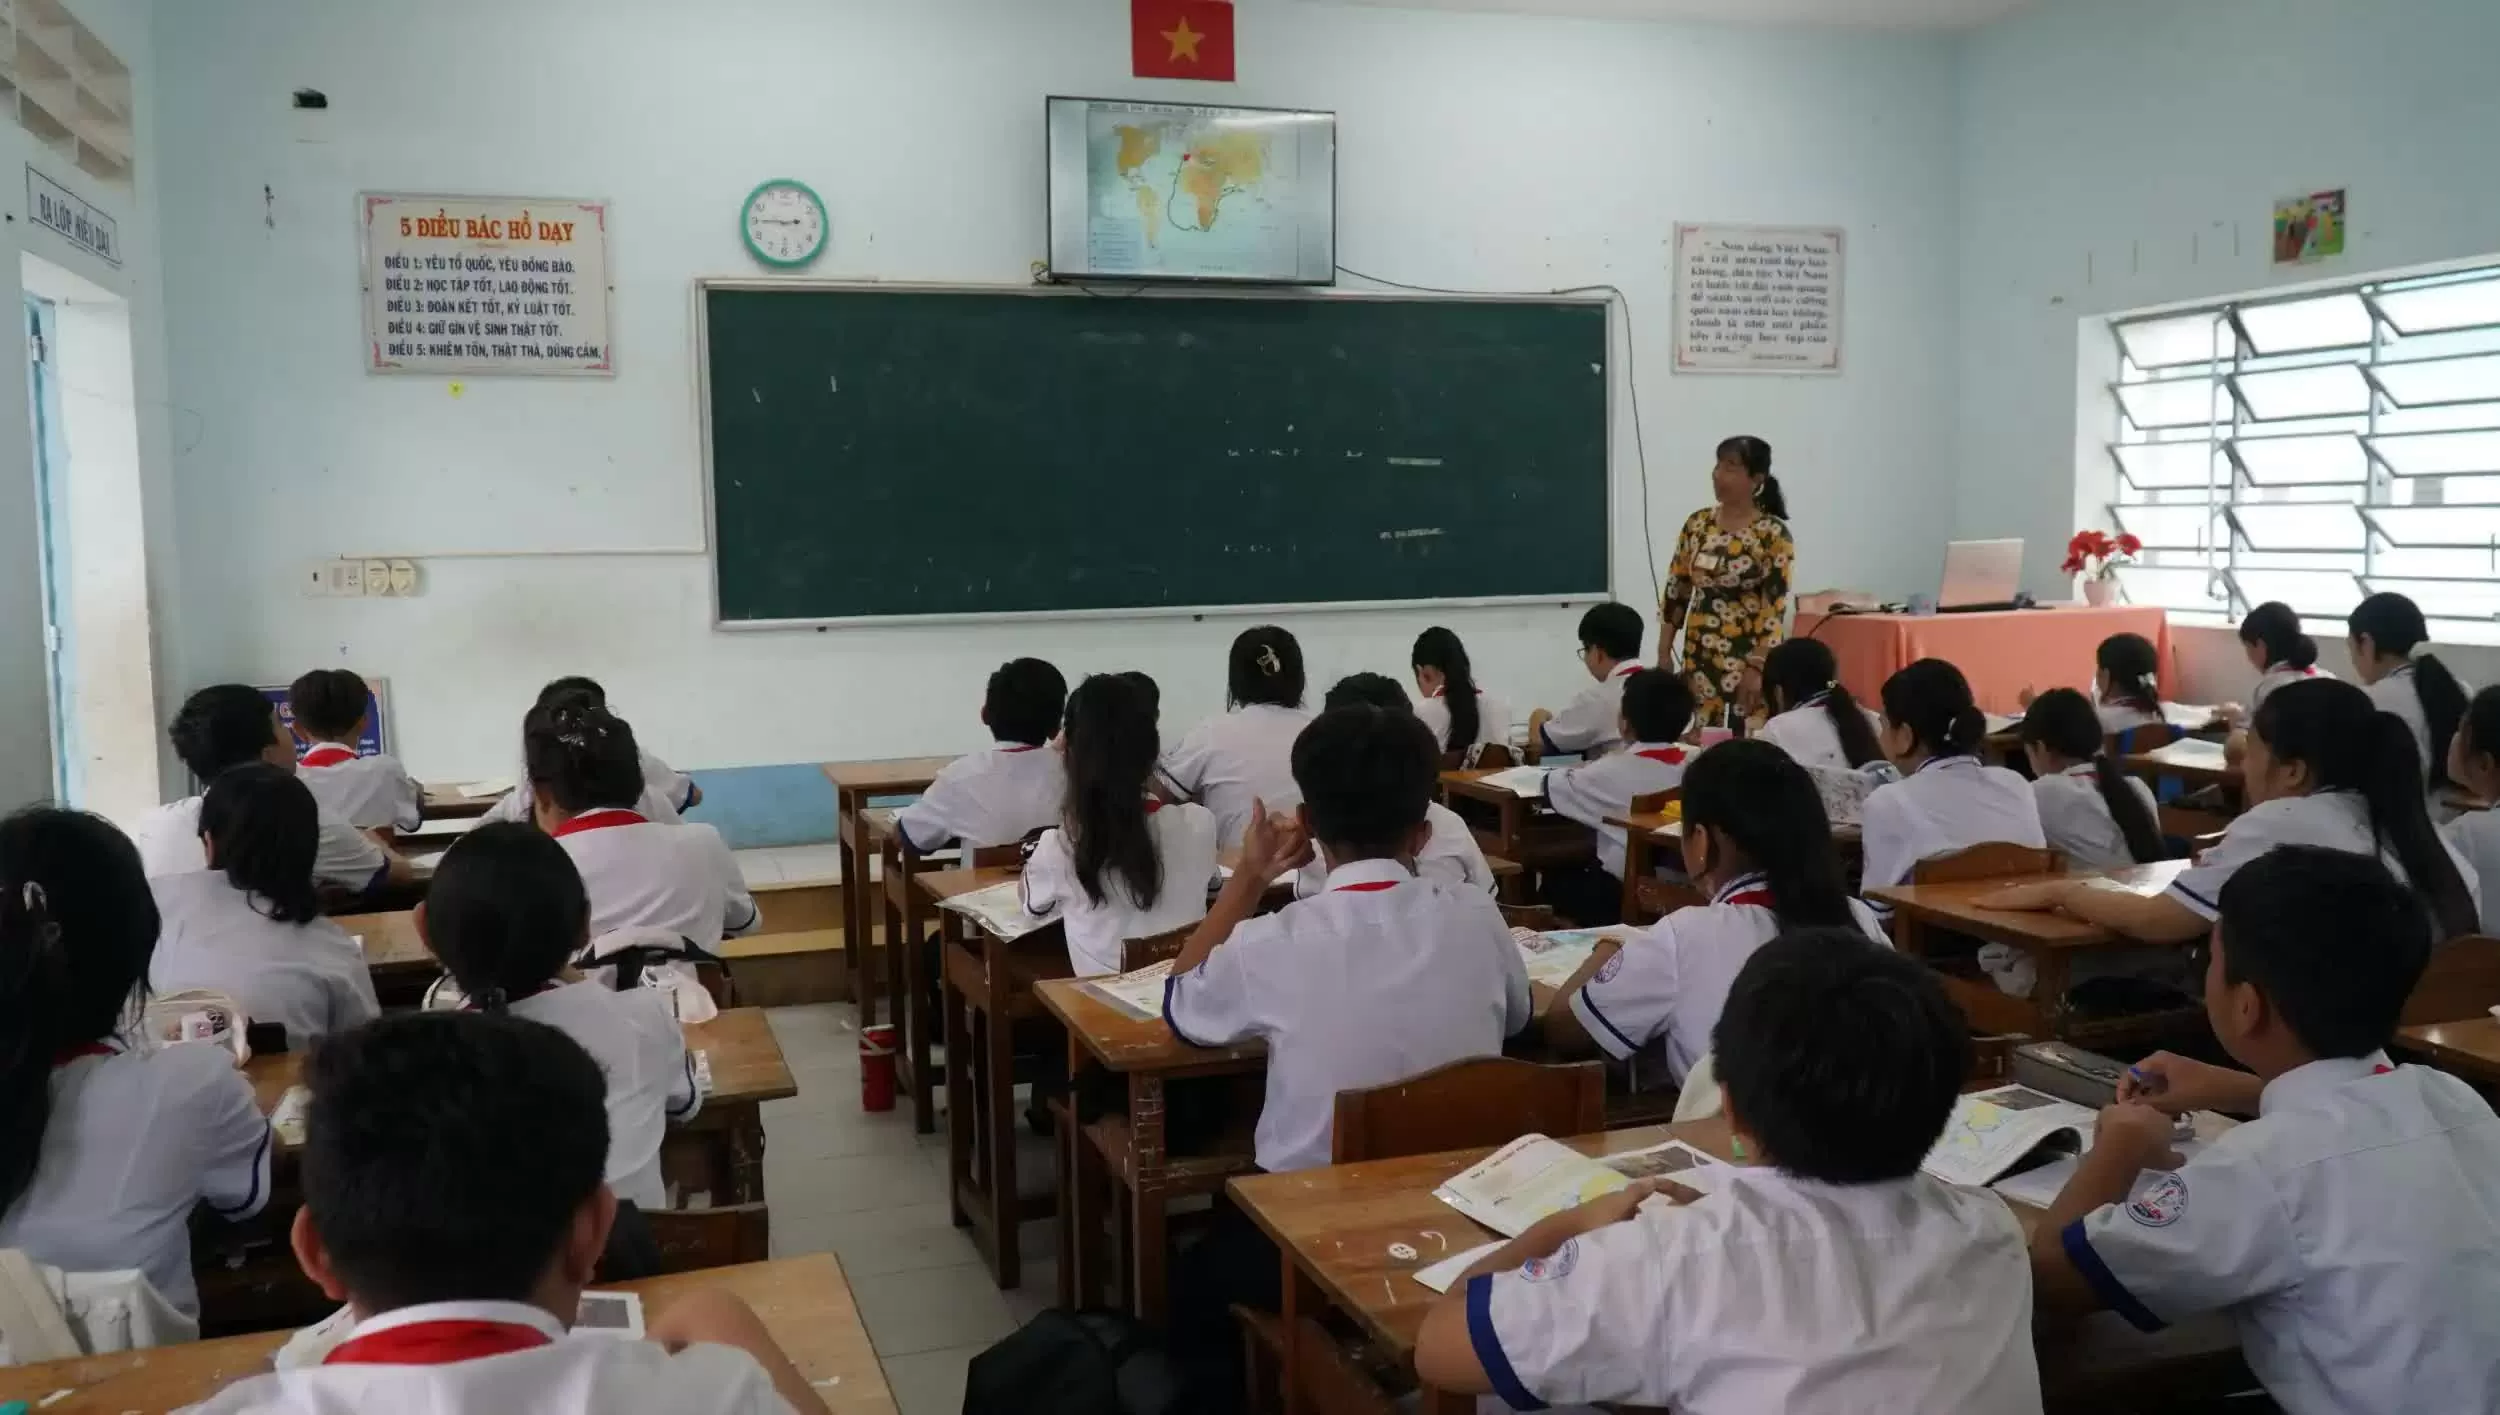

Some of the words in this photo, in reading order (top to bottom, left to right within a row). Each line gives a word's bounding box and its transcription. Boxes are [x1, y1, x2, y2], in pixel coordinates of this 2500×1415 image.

[401, 216, 412, 237] 5
[465, 214, 502, 240] BÁC
[508, 210, 532, 240] HỒ
[539, 221, 574, 246] DẠY
[385, 252, 409, 269] ĐIỀU
[414, 256, 422, 269] 1:
[425, 253, 446, 269] YÊU
[465, 252, 496, 272] QUỐC,
[386, 272, 410, 291] ĐIỀU
[413, 278, 424, 291] 2:
[426, 280, 448, 294] HỌC
[499, 280, 519, 293] LAO
[521, 278, 549, 296] ĐỘNG
[388, 296, 411, 313] ĐIỀU
[416, 300, 424, 313] 3:
[427, 299, 456, 313] ĐOÀN
[458, 296, 478, 313] KẾT
[388, 318, 412, 334] ĐIỀU
[416, 321, 425, 334] 4:
[428, 319, 447, 335] GIỮ
[468, 319, 481, 336] VỆ
[484, 323, 508, 336] SINH
[510, 320, 537, 338] THẬT
[389, 339, 413, 357] ĐIỀU
[416, 343, 426, 357] 5:
[491, 341, 518, 359] THẬT
